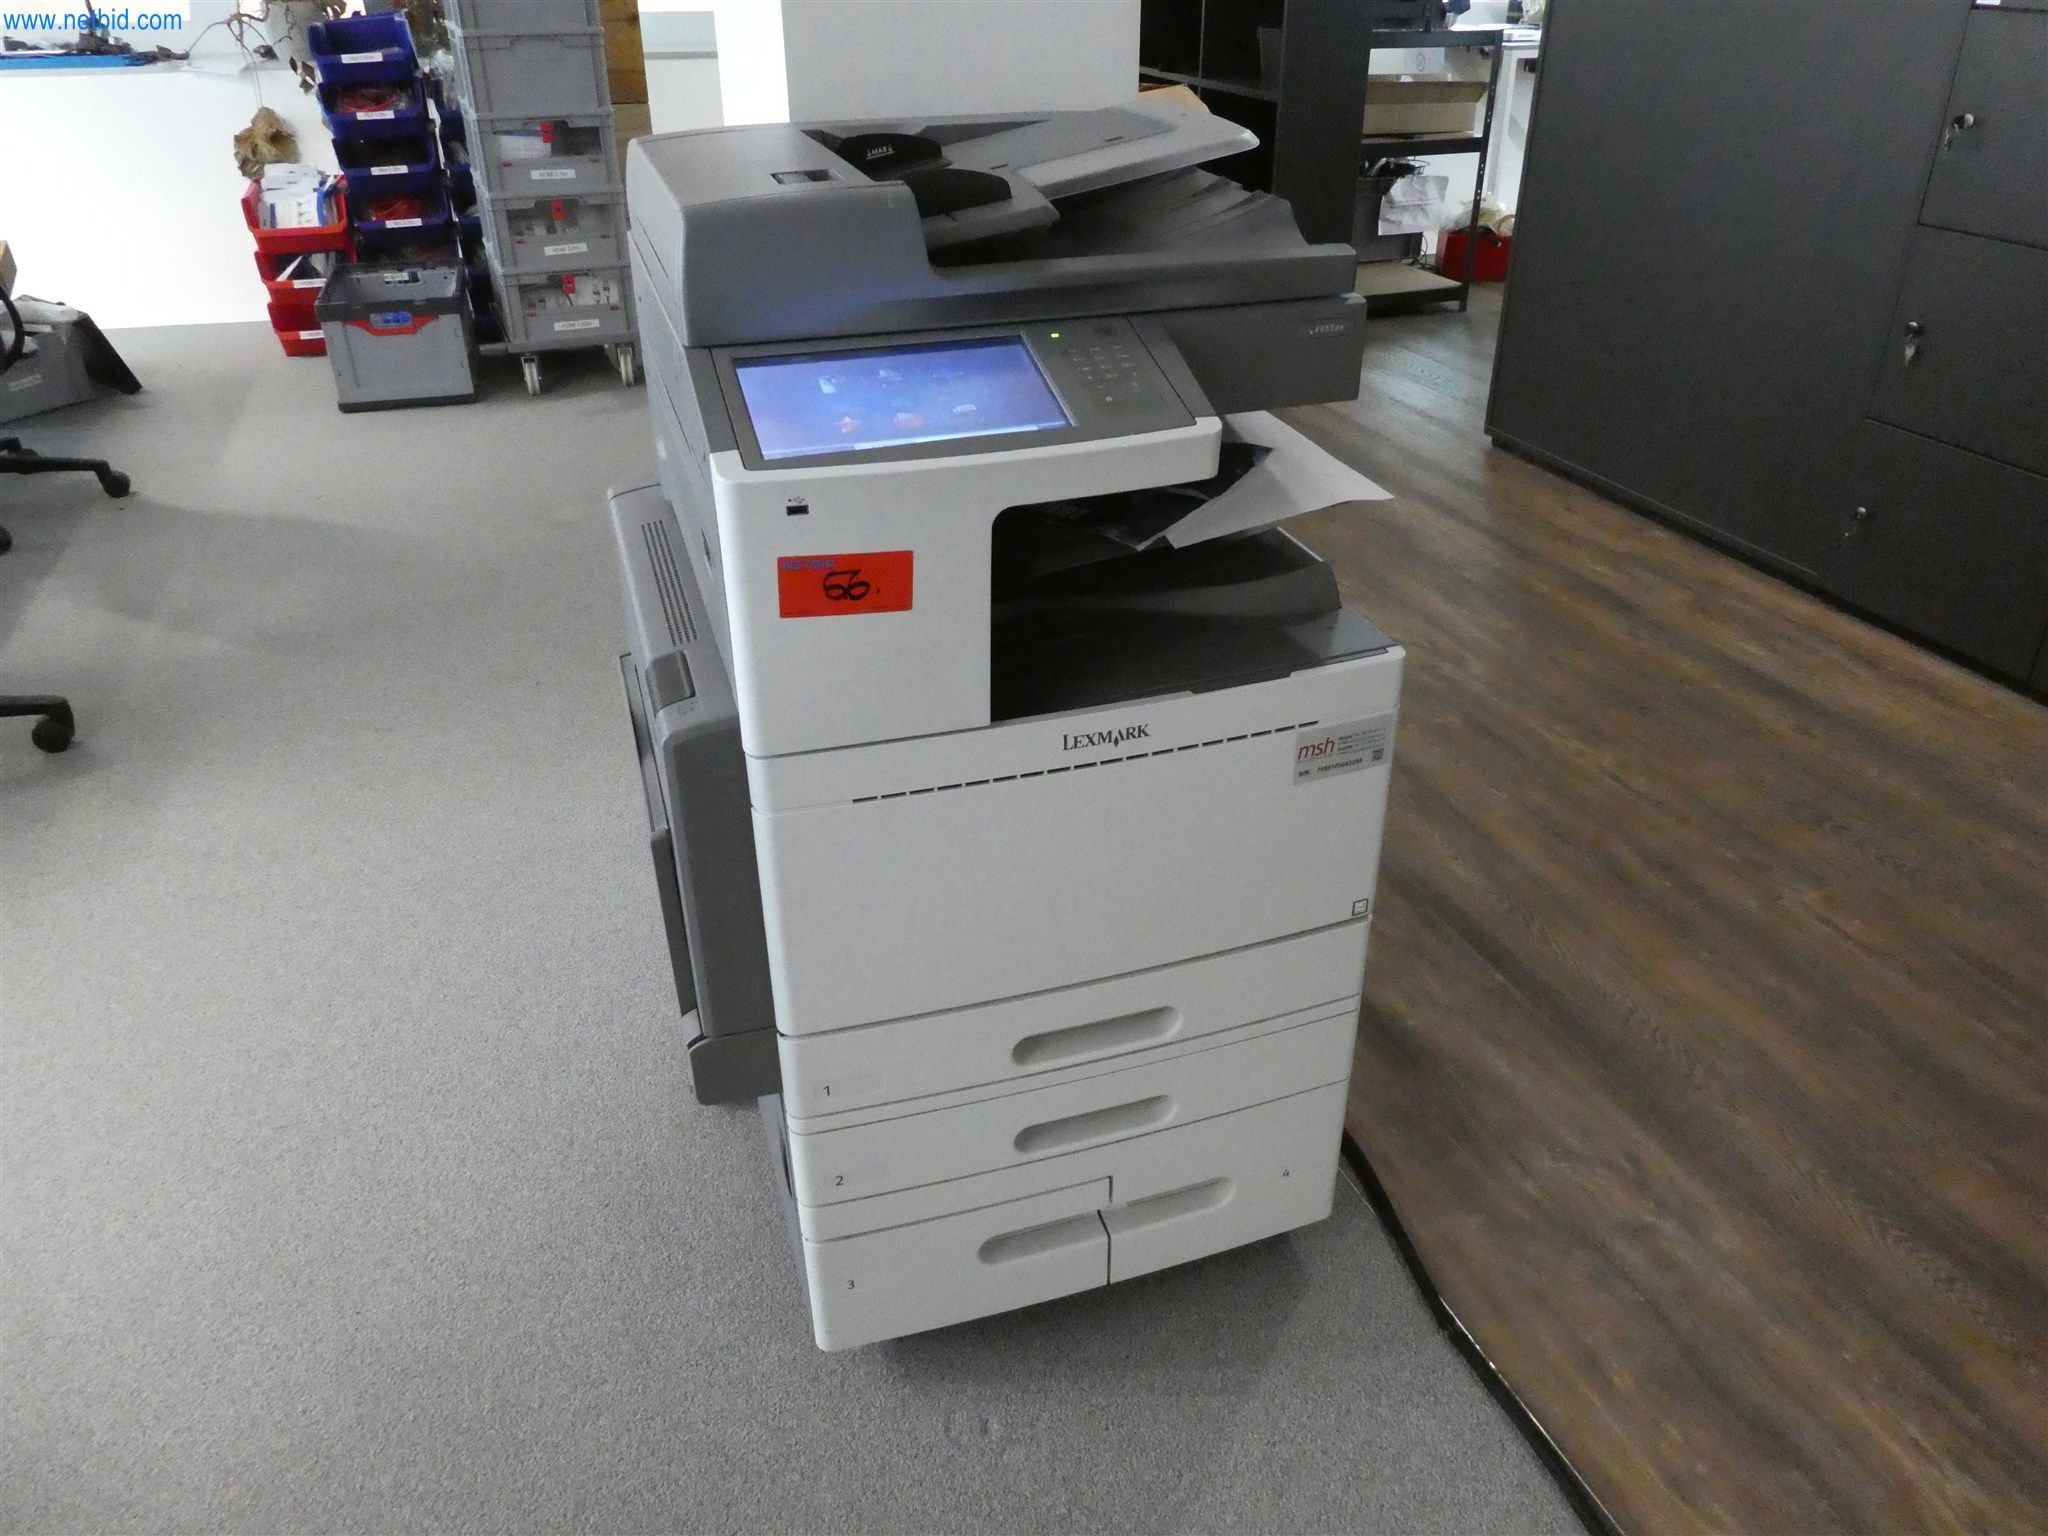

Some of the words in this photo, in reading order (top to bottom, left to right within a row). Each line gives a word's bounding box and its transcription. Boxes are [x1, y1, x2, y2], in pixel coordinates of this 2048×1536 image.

[1063, 724, 1150, 751] LEXMARK
[1298, 737, 1335, 760] msh
[823, 1085, 831, 1096] 1
[835, 1175, 845, 1186] 2
[847, 1279, 856, 1290] 3
